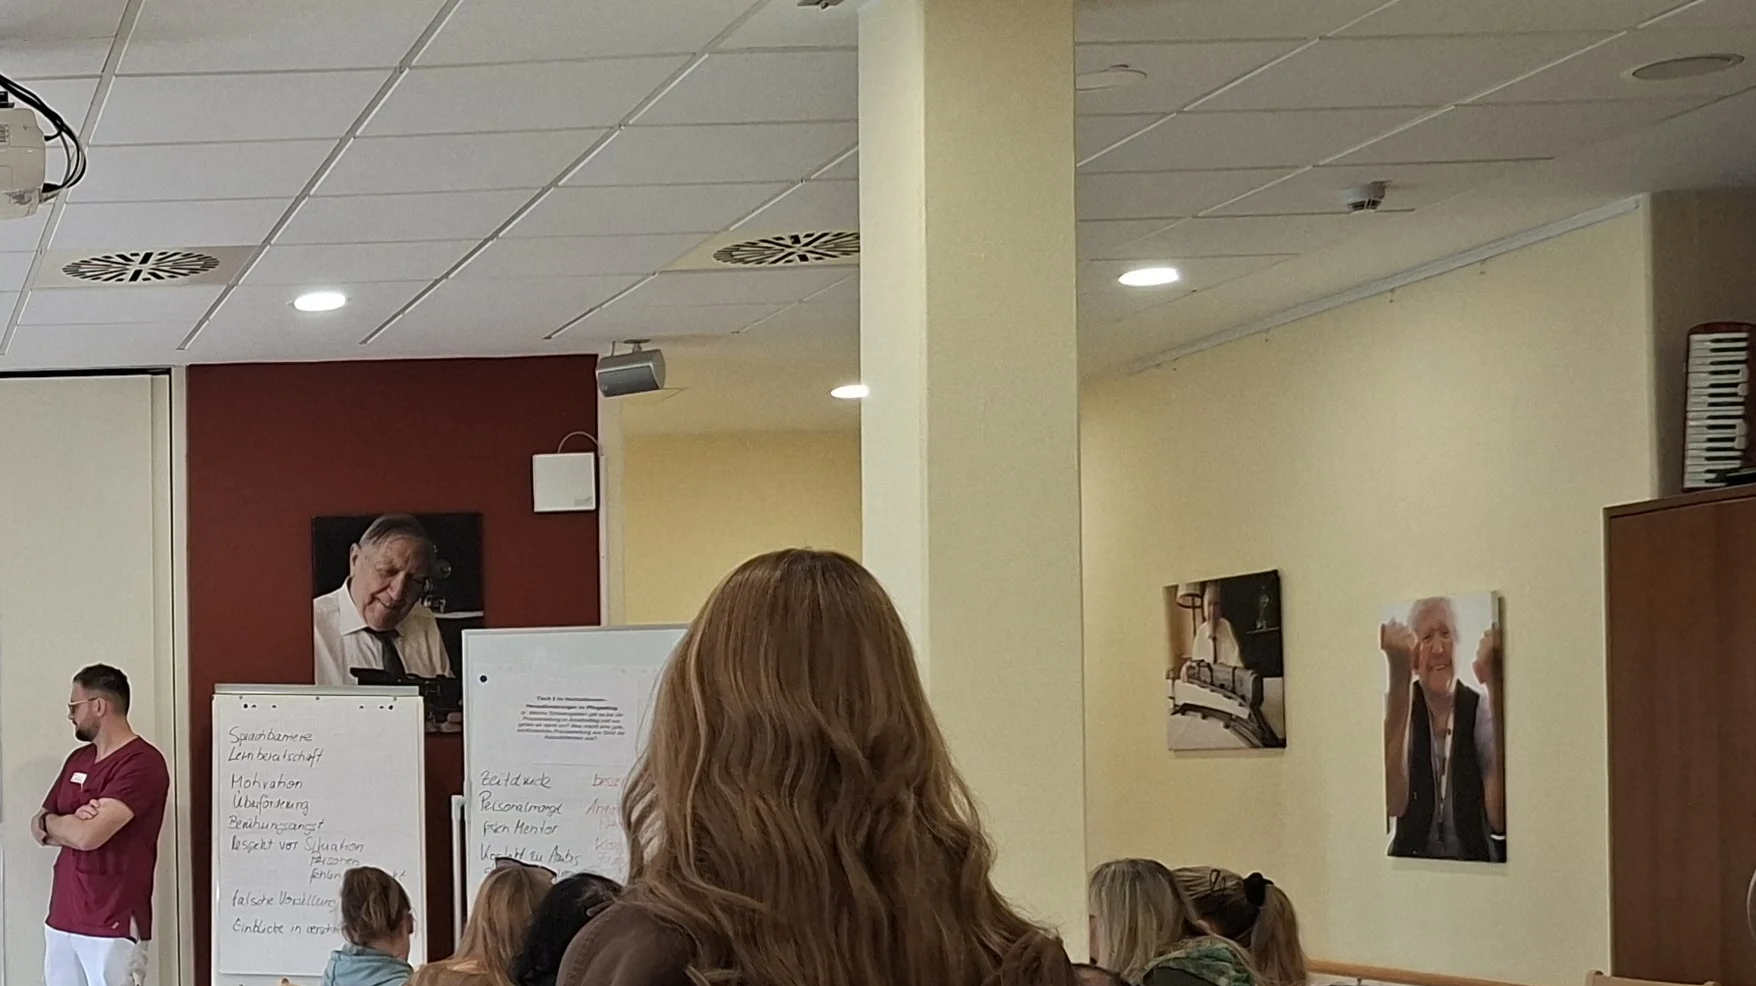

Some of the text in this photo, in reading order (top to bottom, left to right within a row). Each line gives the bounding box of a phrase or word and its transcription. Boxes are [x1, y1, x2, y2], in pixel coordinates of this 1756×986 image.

[228, 726, 313, 747] Sprachbarriere
[231, 772, 303, 790] Motivation
[480, 770, 552, 789] Zeitdruck
[514, 819, 559, 835] Mentor
[279, 841, 298, 850] vor
[232, 917, 284, 934] Einblicke
[291, 924, 302, 934] in
